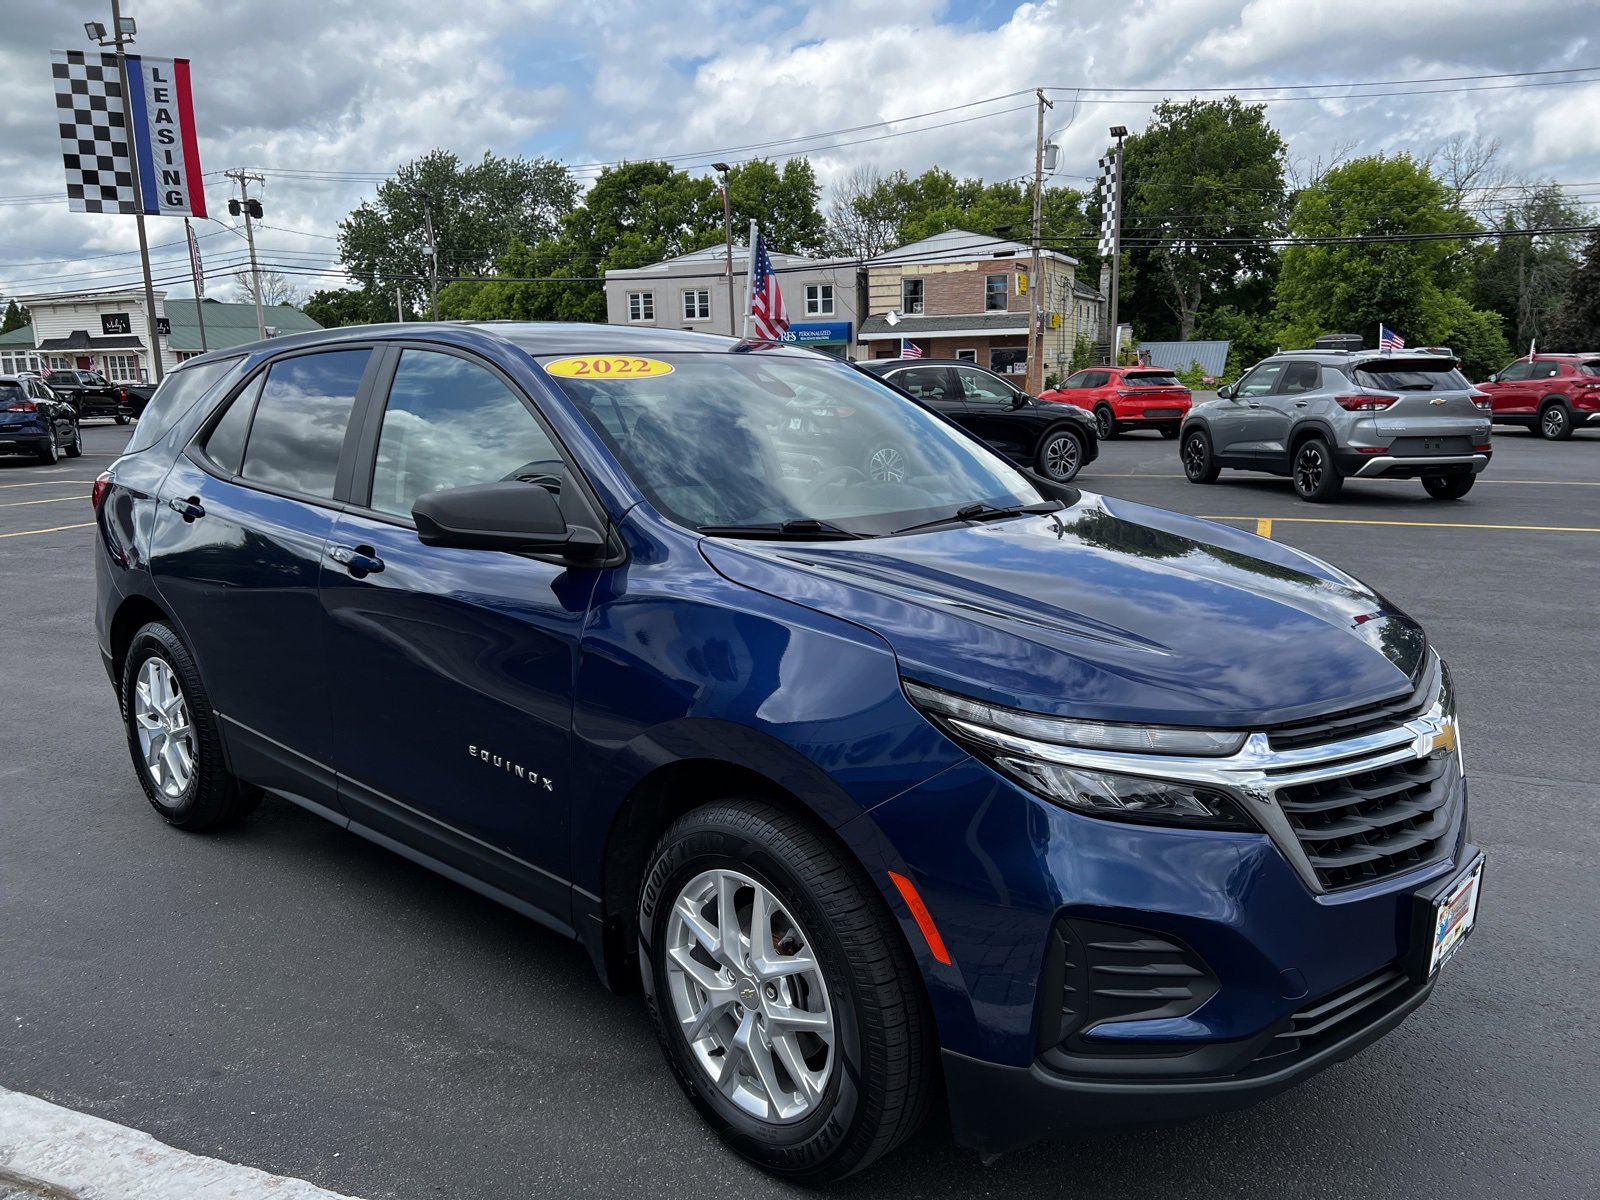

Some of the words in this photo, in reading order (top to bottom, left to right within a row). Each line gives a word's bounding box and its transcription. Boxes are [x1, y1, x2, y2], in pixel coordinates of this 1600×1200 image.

[152, 68, 183, 206] LEASING
[776, 331, 797, 341] RES
[571, 359, 652, 375] 2022
[469, 745, 553, 792] EQUINOX
